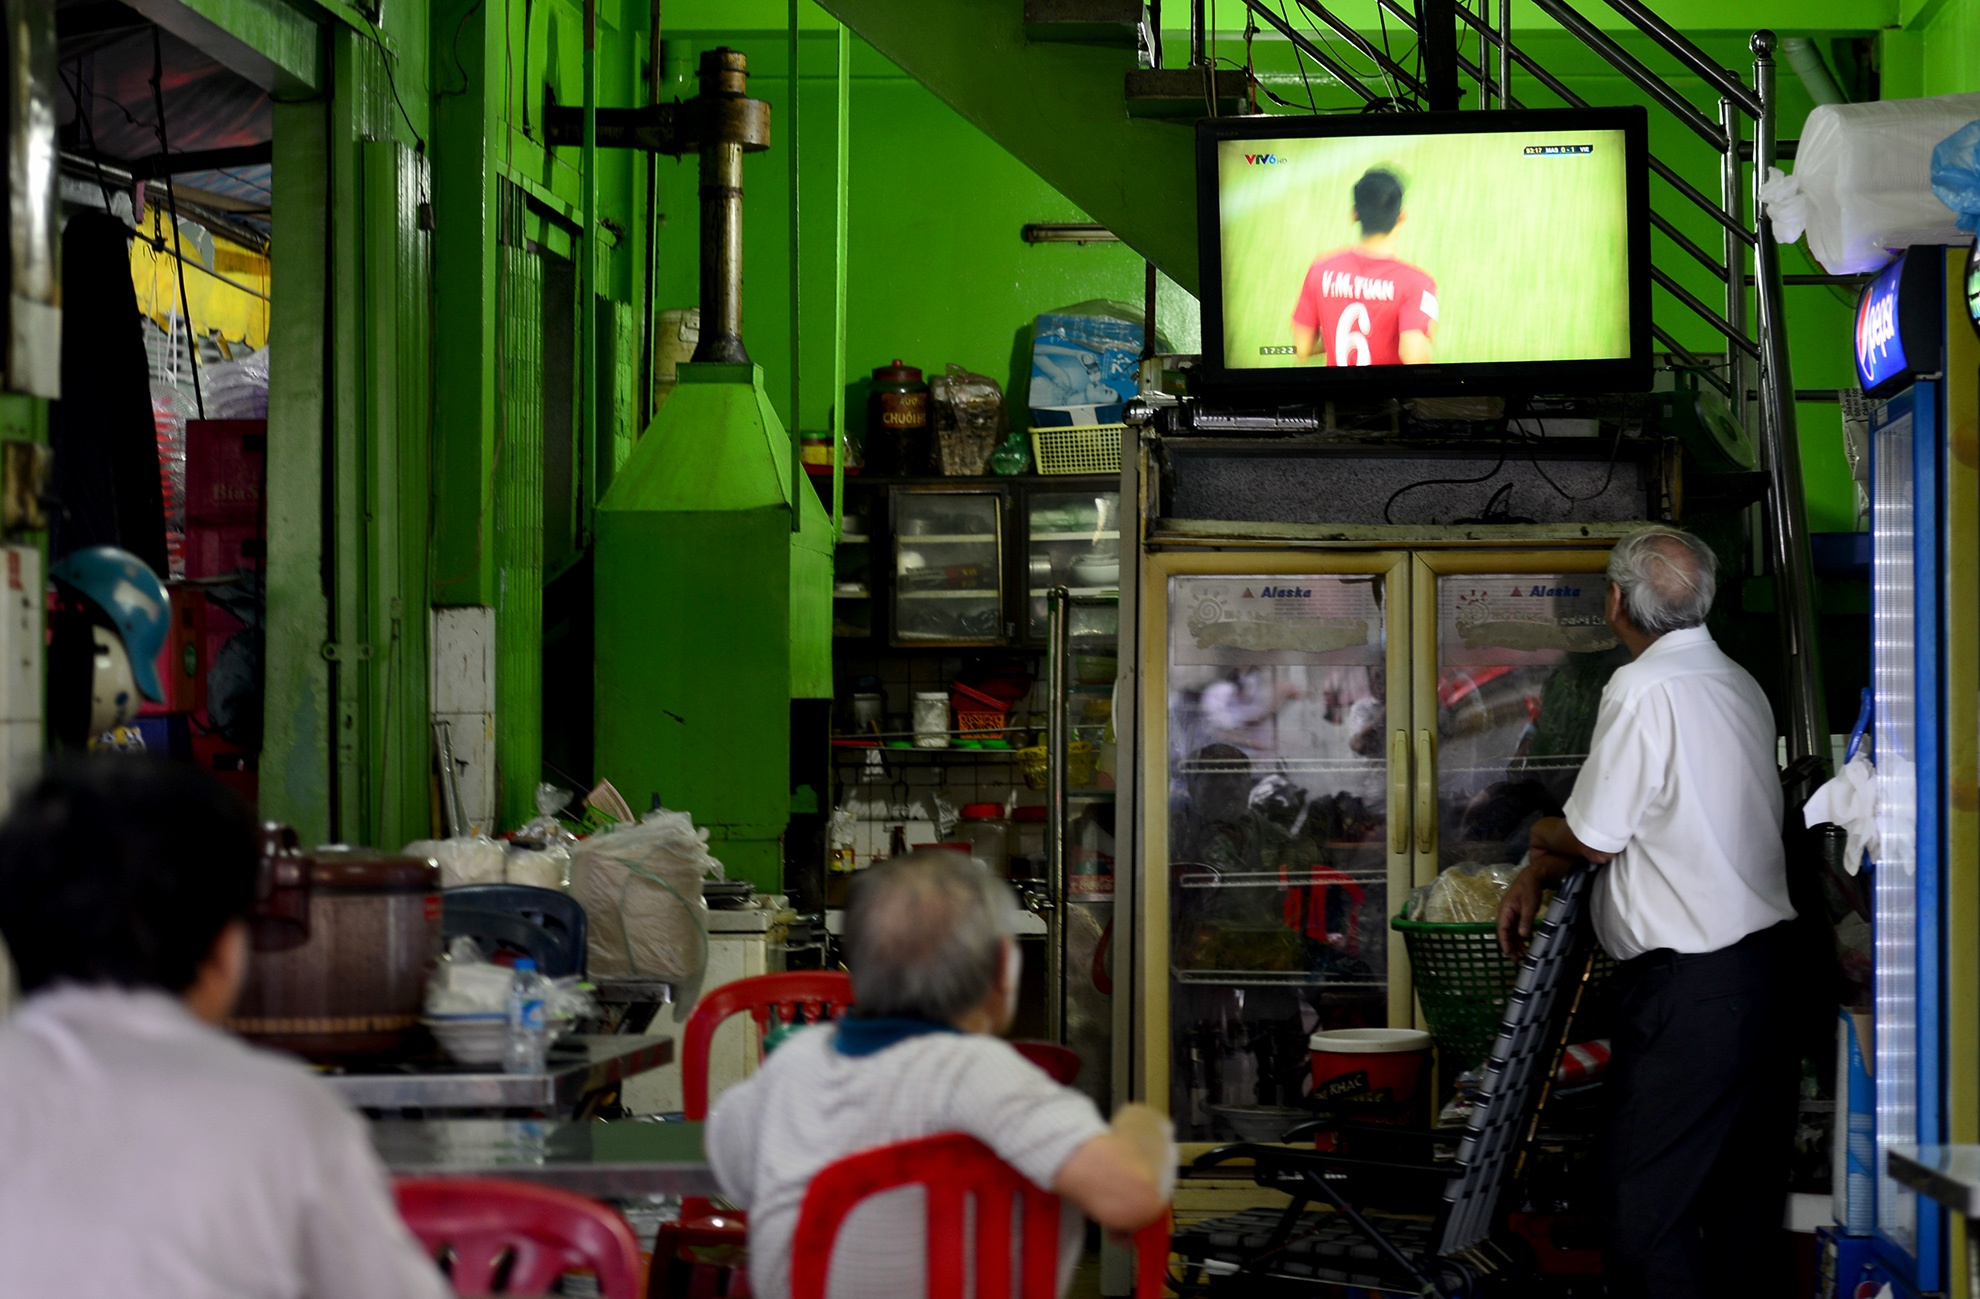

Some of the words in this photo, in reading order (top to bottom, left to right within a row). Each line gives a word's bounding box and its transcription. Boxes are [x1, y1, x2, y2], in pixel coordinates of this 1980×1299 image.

[1244, 154, 1276, 165] VTV6
[1869, 280, 1896, 364] pepsi
[1335, 302, 1371, 366] 6
[1261, 586, 1312, 598] Alaska
[1529, 585, 1582, 597] Alaska
